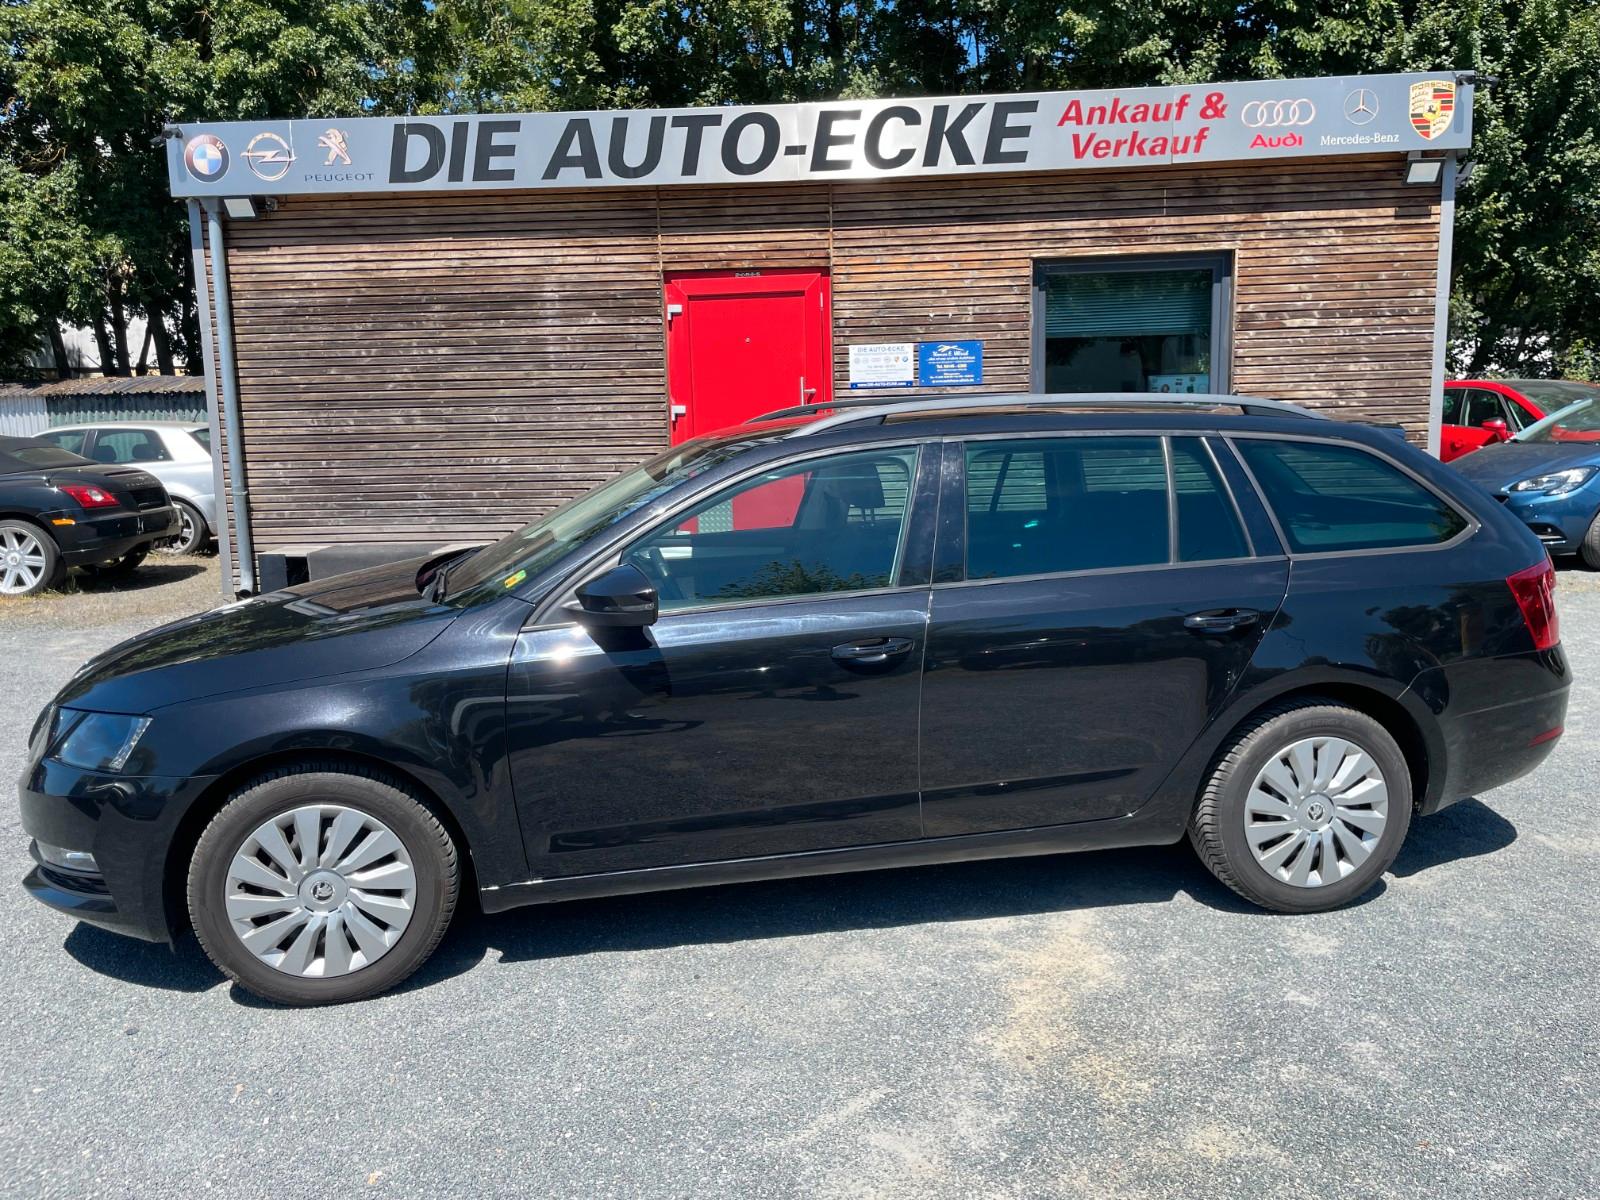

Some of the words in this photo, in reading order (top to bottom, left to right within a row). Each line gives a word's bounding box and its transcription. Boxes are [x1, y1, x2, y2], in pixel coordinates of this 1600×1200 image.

[1412, 81, 1454, 92] PORSCHE
[1056, 94, 1191, 127] Ankauf
[1199, 92, 1228, 120] &
[389, 120, 521, 184] DIE
[541, 100, 1040, 180] AUTO-ECKE
[1072, 127, 1210, 160] Verkauf
[1250, 133, 1303, 149] Audi
[1320, 132, 1400, 146] Mercedes-Benz
[304, 173, 375, 183] PEUGEOT
